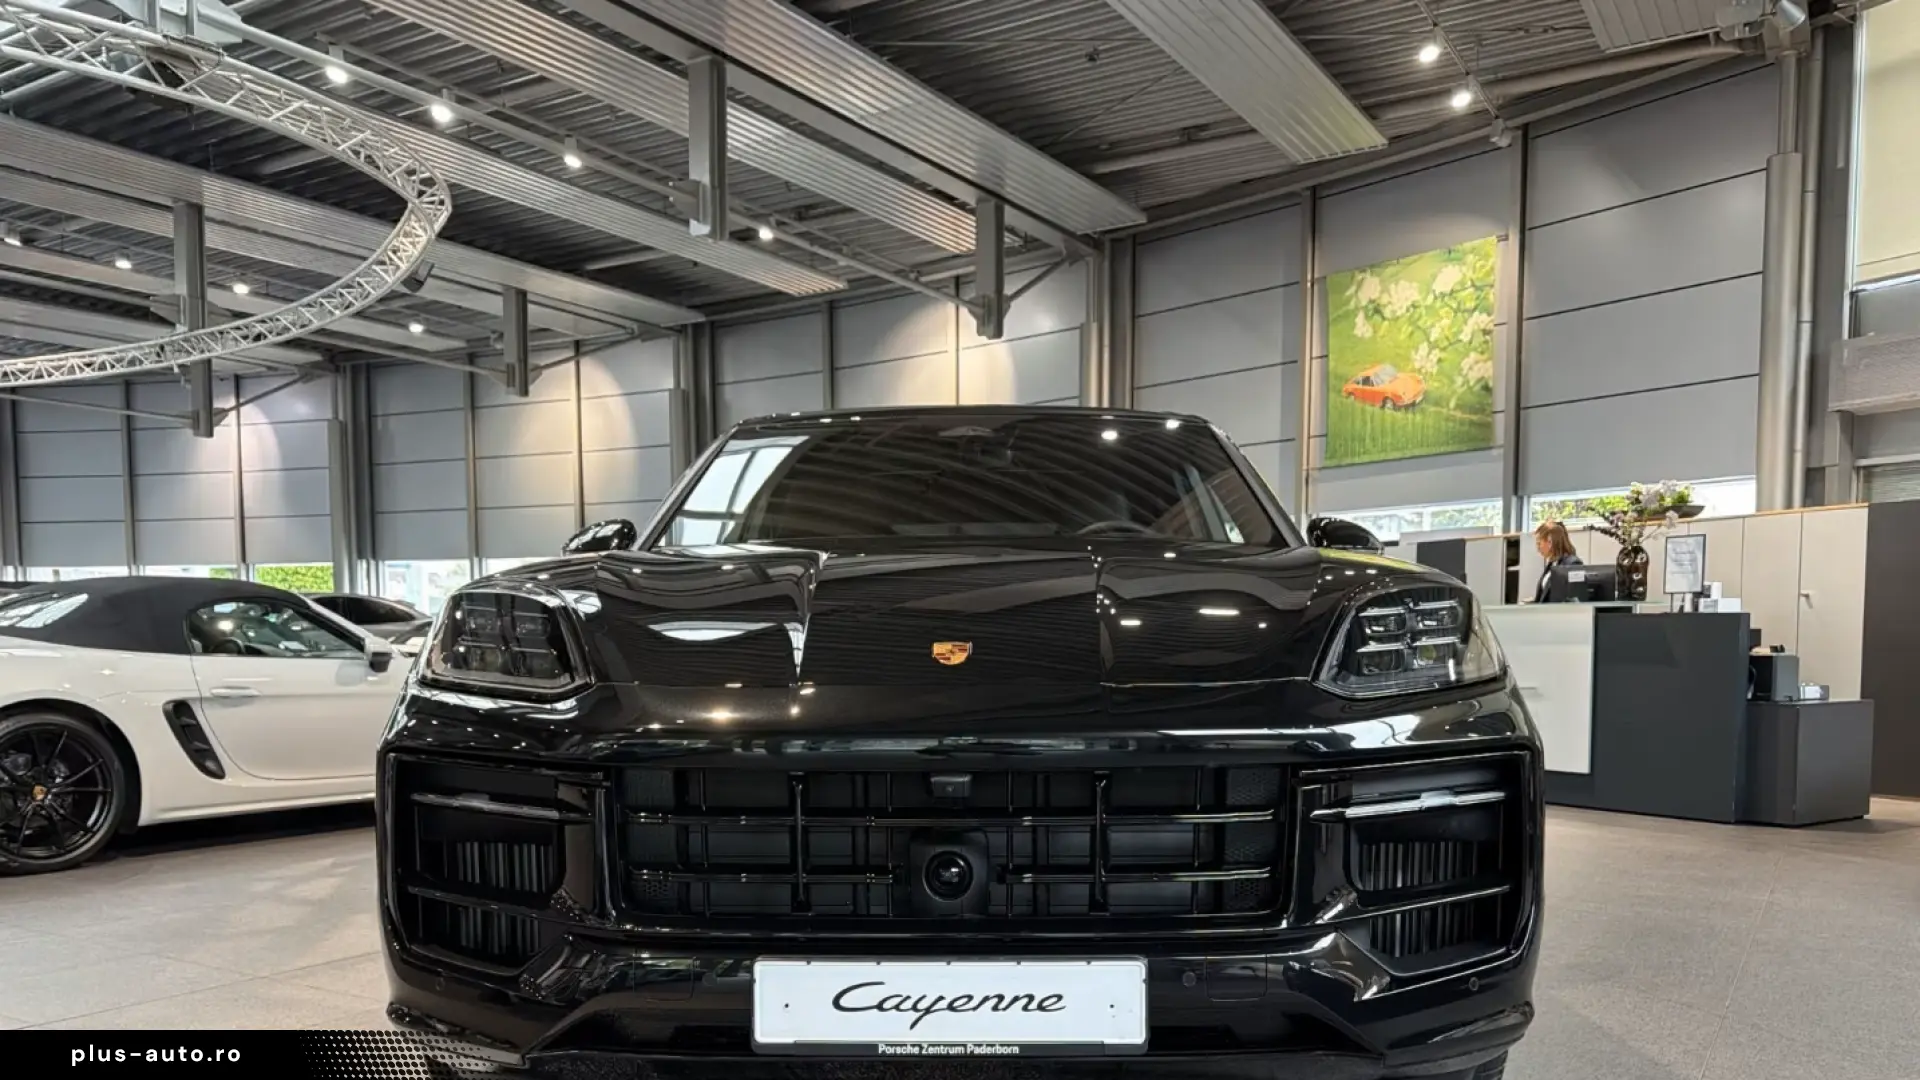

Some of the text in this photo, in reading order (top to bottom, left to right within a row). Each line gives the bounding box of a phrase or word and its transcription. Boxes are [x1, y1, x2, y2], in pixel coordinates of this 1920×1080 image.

[832, 981, 1066, 1030] Cayenne
[878, 1043, 1020, 1055] Porsche Zentrum Paderborn
